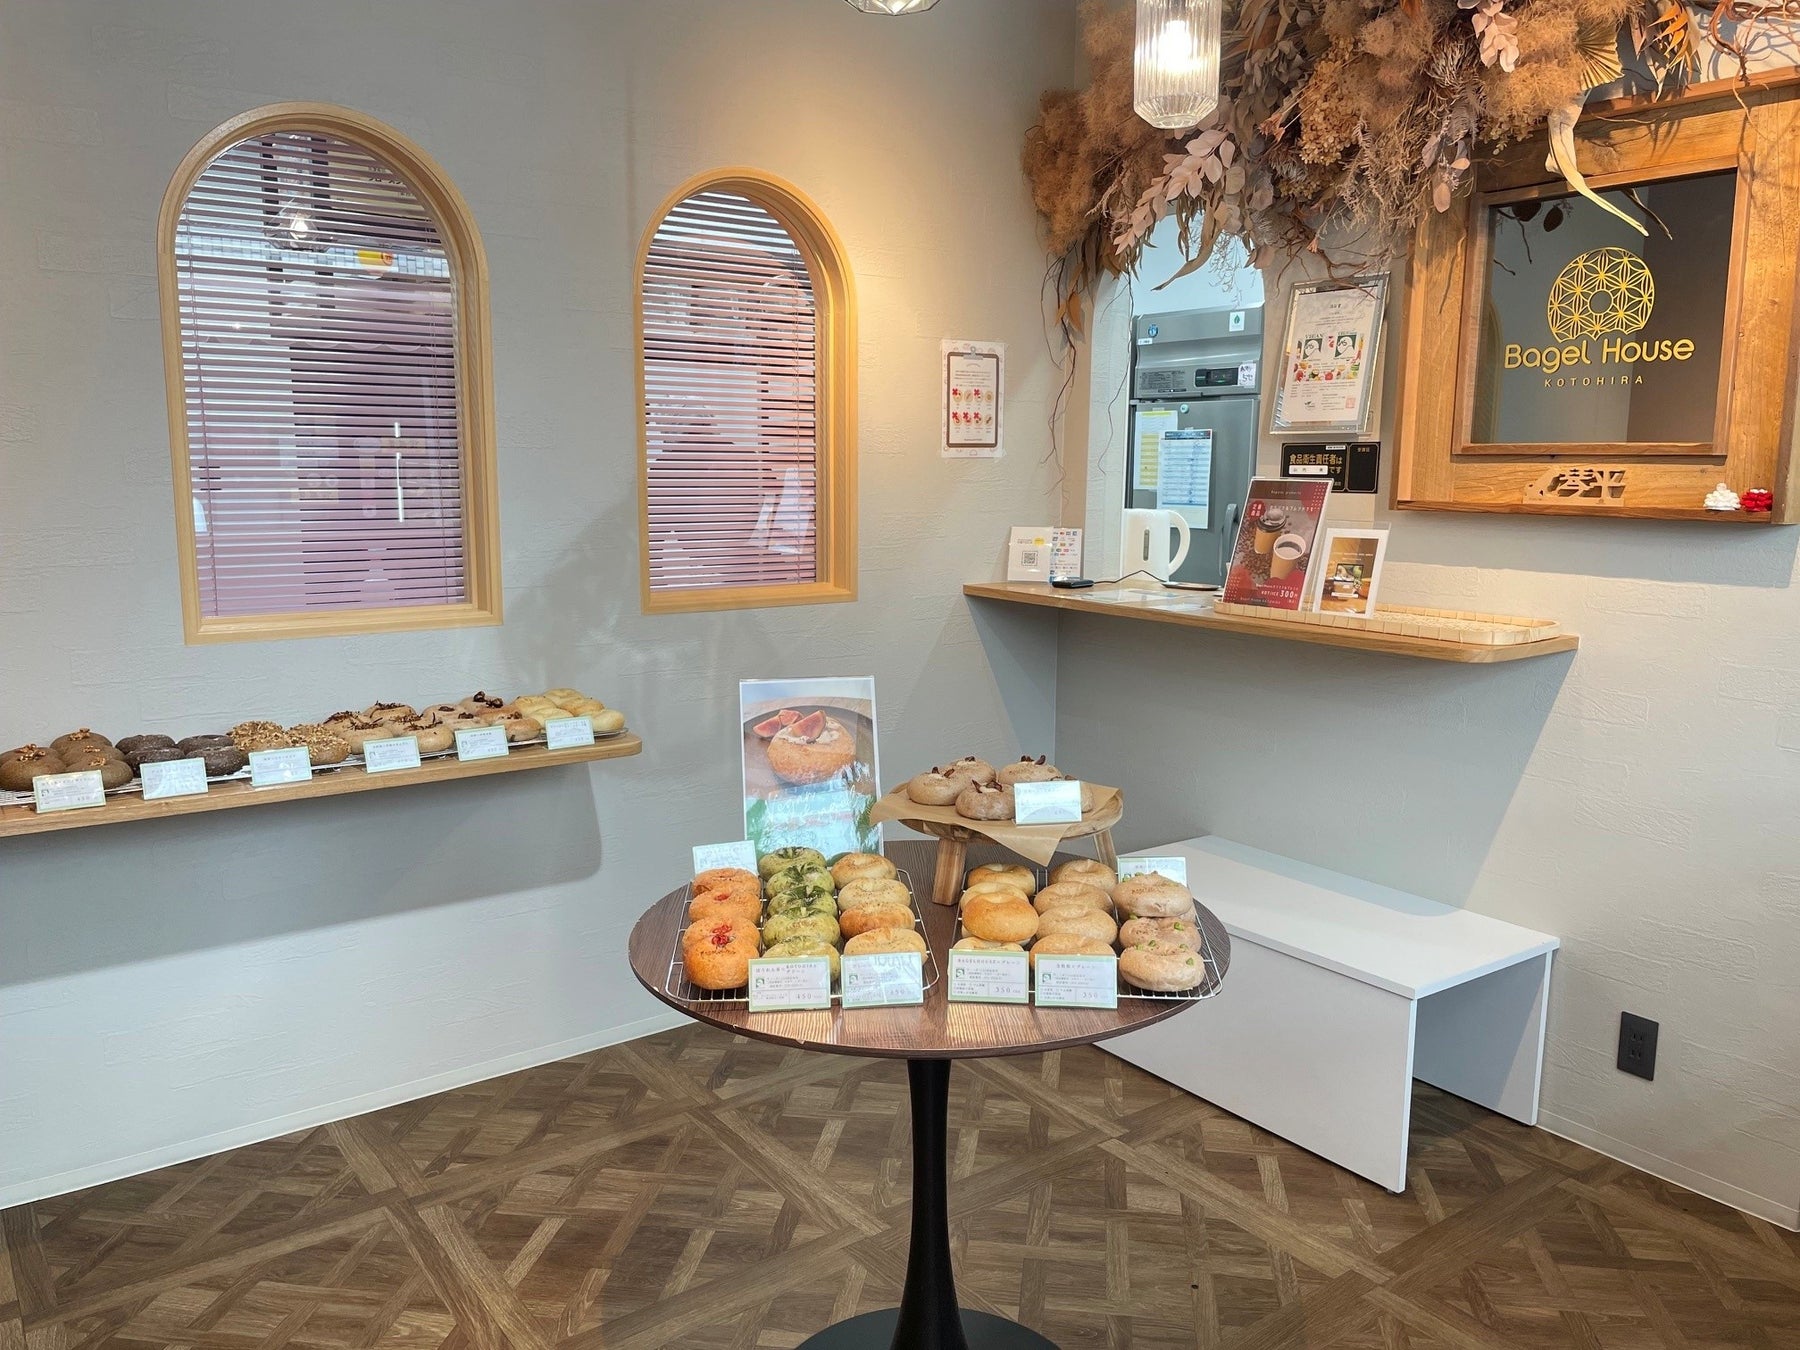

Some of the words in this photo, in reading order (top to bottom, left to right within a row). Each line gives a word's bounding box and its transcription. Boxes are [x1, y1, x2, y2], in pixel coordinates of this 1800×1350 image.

[1504, 340, 1591, 373] Bagel
[1602, 337, 1695, 363] House
[1544, 375, 1643, 387] KOTOHIRA
[1289, 453, 1343, 465] 食品衛生責任者は
[1328, 466, 1342, 474] です
